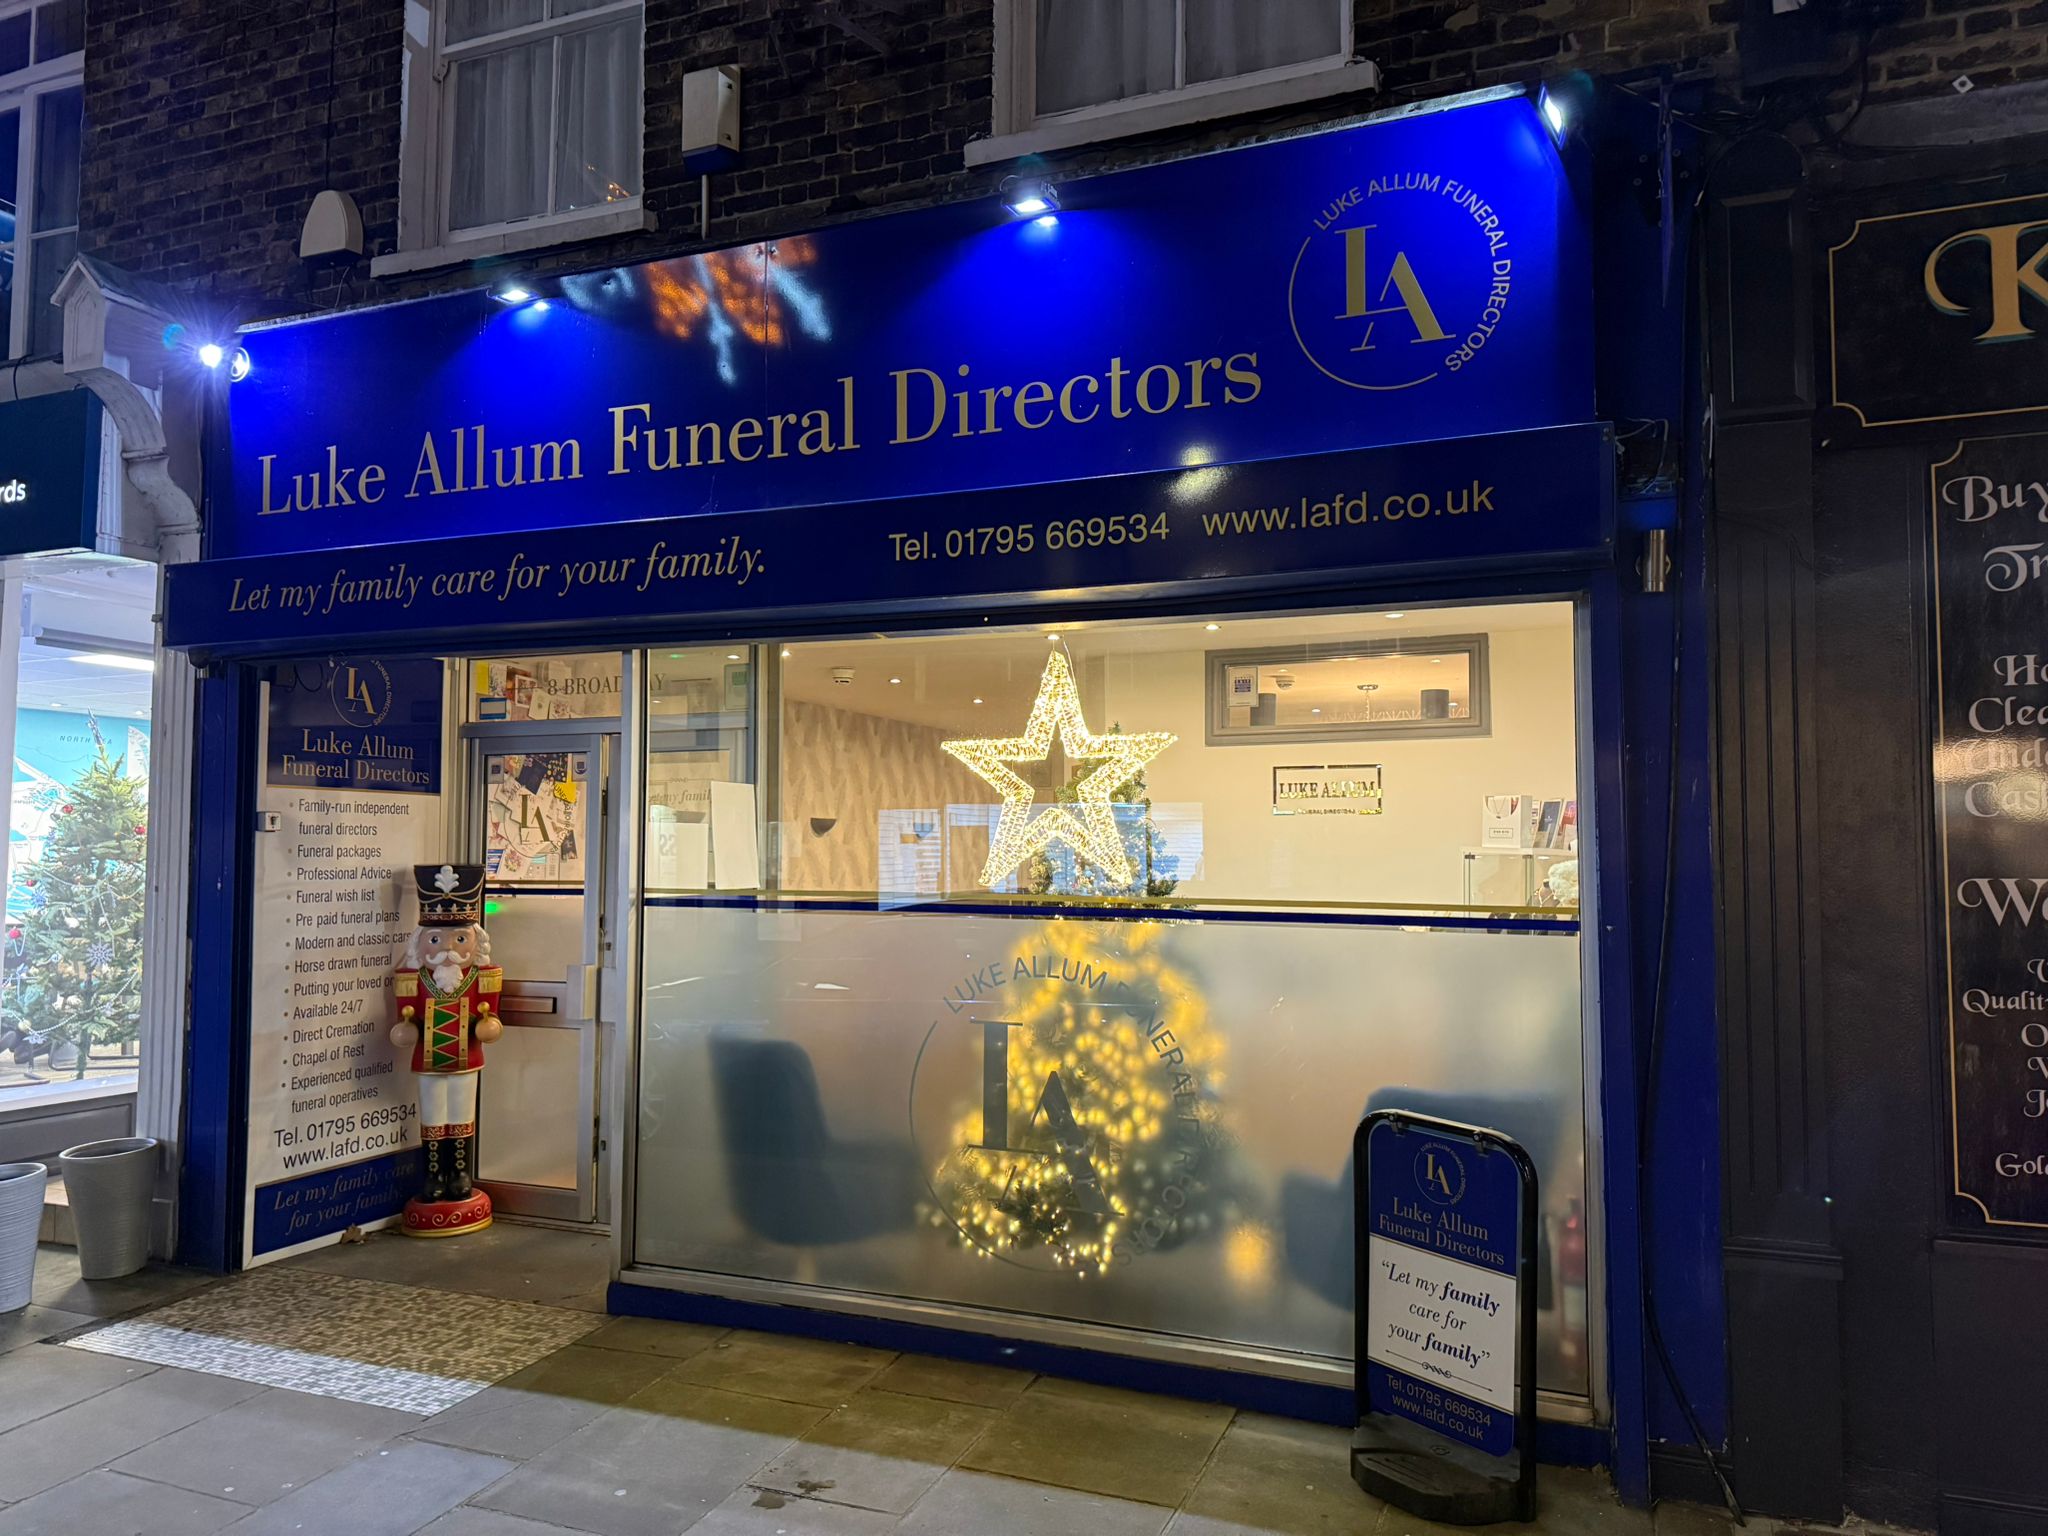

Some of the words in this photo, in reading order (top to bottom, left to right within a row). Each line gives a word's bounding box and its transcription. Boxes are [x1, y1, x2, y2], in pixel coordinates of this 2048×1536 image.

[1368, 172, 1441, 198] ALLUM
[1313, 186, 1364, 231] LUKE
[1442, 179, 1509, 257] FUNERAL
[1445, 259, 1512, 372] DIRECTORS
[257, 446, 386, 516] Luke
[404, 425, 584, 499] Allum
[607, 376, 861, 475] Funeral
[889, 350, 1263, 445] Directors
[889, 532, 937, 562] Tel.
[944, 522, 1035, 559] 01795
[1046, 512, 1170, 552] 669534
[1202, 480, 1496, 537] www.lafd.co.uk
[229, 578, 270, 612] Let
[279, 586, 321, 614] my
[322, 564, 423, 614] family
[431, 567, 495, 596] care
[498, 552, 550, 601] for
[559, 555, 635, 597] your
[637, 535, 767, 591] family.
[302, 728, 353, 755] Luke
[358, 733, 415, 760] Allum
[282, 754, 349, 779] Funeral
[356, 759, 430, 785] Directors
[299, 799, 351, 816] Family-run
[354, 800, 410, 816] independent
[299, 821, 333, 835] funeral
[336, 822, 377, 836] directors
[297, 844, 334, 858] Funeral
[336, 845, 381, 860] packages
[297, 866, 358, 880] Professional
[360, 866, 392, 880] Advice
[296, 889, 332, 904] Funeral
[335, 888, 358, 903] wish
[361, 889, 375, 902] list
[295, 913, 313, 927] Pre
[316, 912, 338, 928] paid
[341, 910, 373, 925] funeral
[375, 909, 400, 925] plans
[295, 936, 334, 950] Modern
[337, 934, 355, 948] and
[357, 931, 390, 946] classic
[294, 960, 325, 973] Horse
[328, 957, 358, 971] drawn
[360, 952, 392, 968] funeral
[294, 982, 329, 997] Putting
[332, 980, 355, 995] your
[356, 976, 381, 991] loved
[943, 961, 1006, 1015] LUKE
[1012, 954, 1108, 990] ALLUM
[293, 1003, 338, 1020] Available
[341, 999, 364, 1015] 24/7
[1962, 987, 2048, 1018] Qualit
[293, 1026, 323, 1043] Direct
[325, 1021, 375, 1040] Cremation
[292, 1050, 328, 1068] Chapel
[330, 1047, 340, 1060] of
[343, 1044, 365, 1059] Rest
[291, 1068, 352, 1091] Experienced
[354, 1060, 393, 1080] qualified
[291, 1097, 326, 1114] funeral
[328, 1087, 379, 1109] operatives
[274, 1127, 303, 1148] Tel.
[306, 1115, 356, 1141] 01795
[360, 1102, 417, 1130] 669534
[282, 1126, 409, 1169] www.lafd.co.uk
[273, 1190, 300, 1211] Let
[305, 1184, 331, 1204] my
[329, 1167, 378, 1200] family
[285, 1209, 312, 1236] for
[315, 1198, 352, 1227] your
[1393, 1196, 1432, 1224] Luke
[1437, 1210, 1489, 1241] Allum
[1379, 1213, 1430, 1244] Funeral
[1436, 1230, 1505, 1266] Directors
[1415, 1276, 1439, 1297] my
[1439, 1281, 1500, 1318] family
[1409, 1303, 1440, 1323] care
[1441, 1310, 1467, 1331] for
[1387, 1322, 1422, 1344] your
[1386, 1373, 1405, 1393] Tel.
[1406, 1382, 1441, 1408] 01795
[1444, 1398, 1492, 1427] 669534
[1391, 1393, 1485, 1441] www.lafd.co.uk
